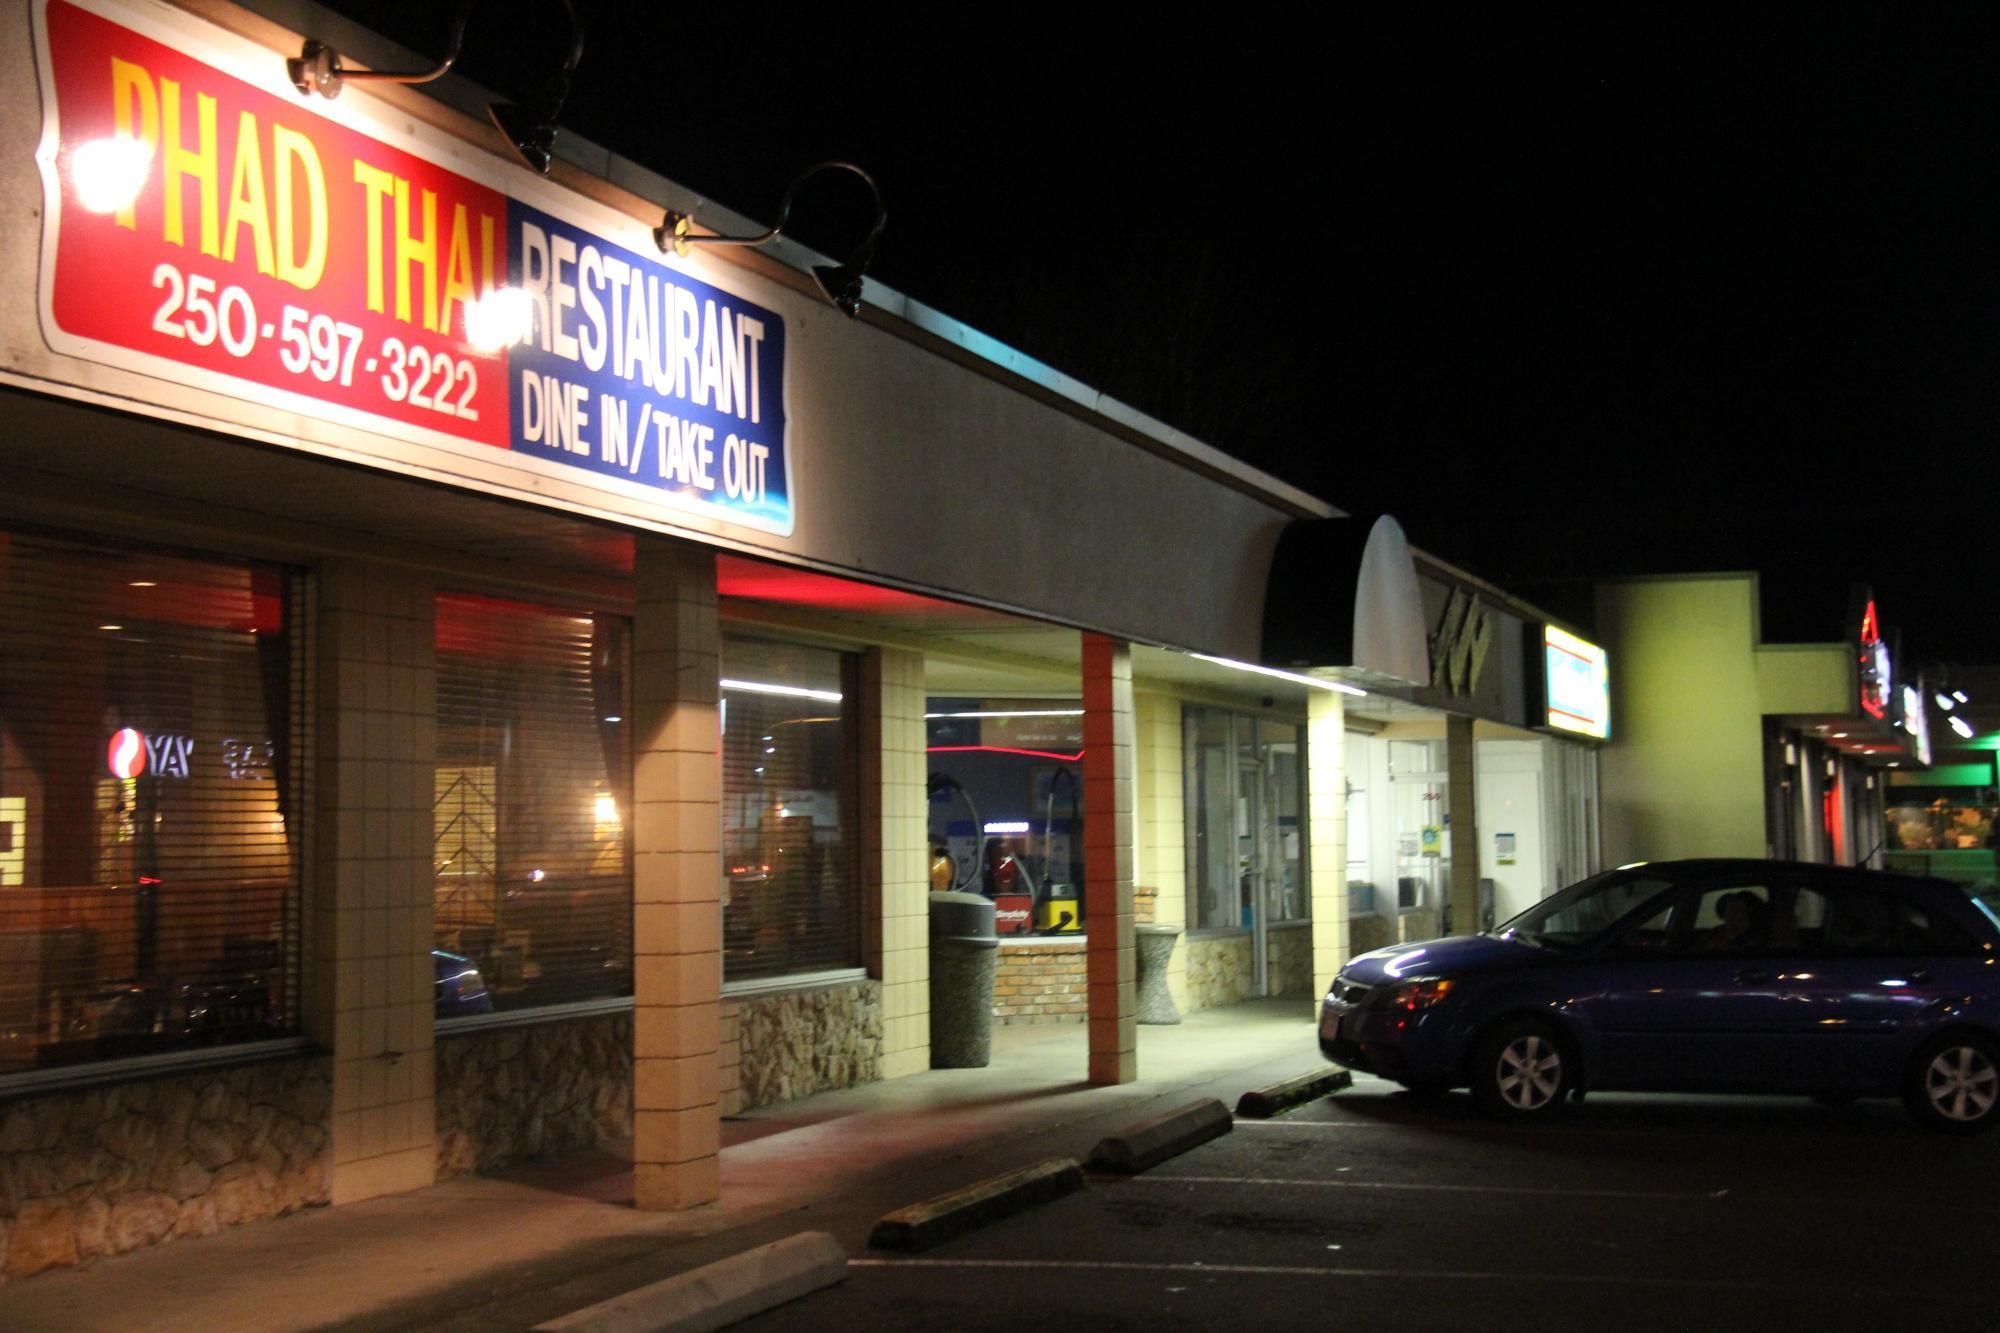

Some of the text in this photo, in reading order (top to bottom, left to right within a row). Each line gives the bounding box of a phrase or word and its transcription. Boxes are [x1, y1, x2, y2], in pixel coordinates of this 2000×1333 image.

[111, 56, 495, 345] PHAD THAI
[521, 221, 765, 424] RESTAURANT
[522, 369, 591, 457] DINE
[723, 433, 770, 505] OUT
